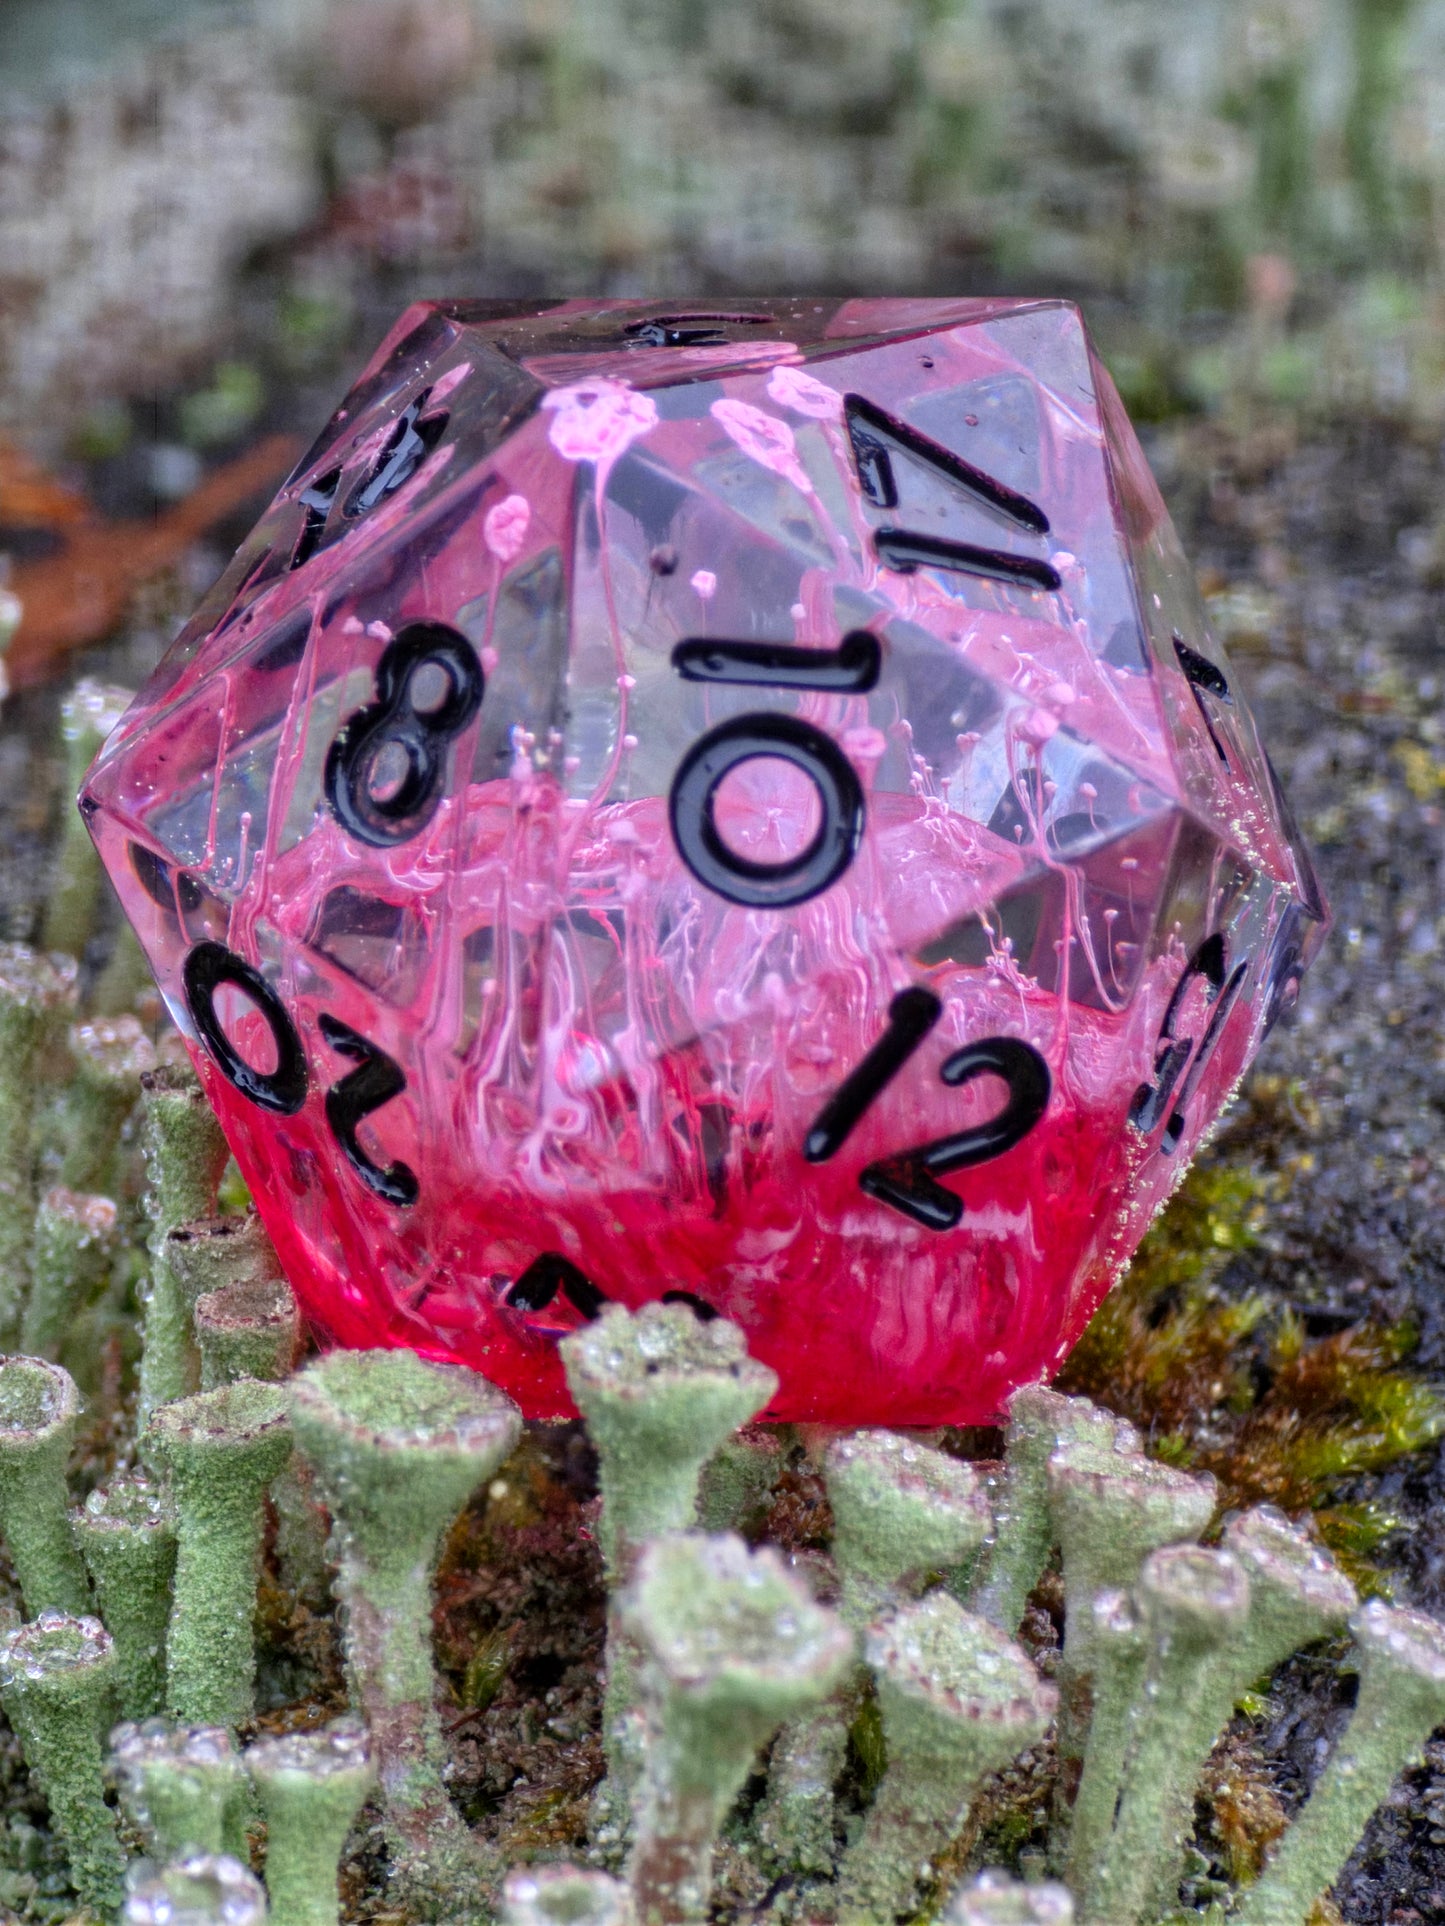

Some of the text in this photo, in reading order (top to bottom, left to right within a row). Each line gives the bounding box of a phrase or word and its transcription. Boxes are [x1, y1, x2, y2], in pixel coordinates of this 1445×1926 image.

[843, 392, 1062, 592] 17
[324, 622, 486, 849] 8
[669, 629, 881, 911] 10
[183, 939, 419, 1208] 20
[804, 986, 1052, 1232] 12
